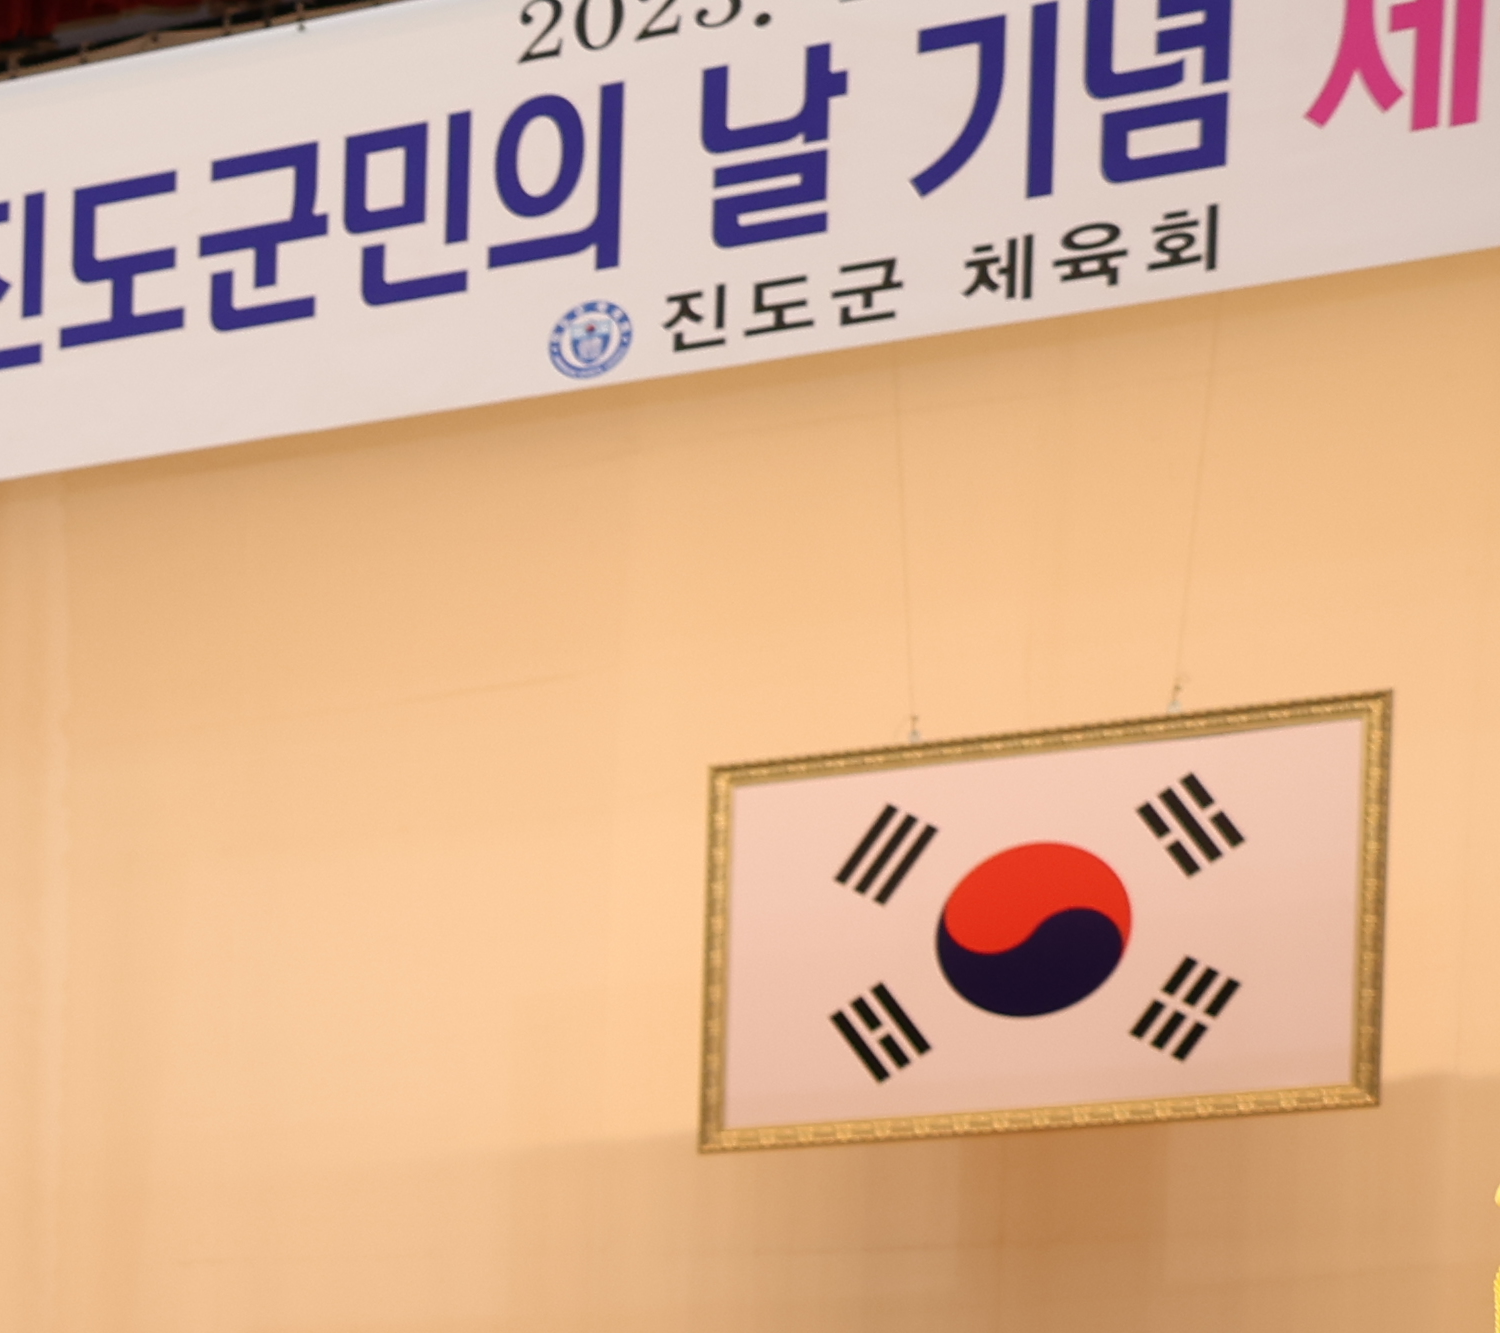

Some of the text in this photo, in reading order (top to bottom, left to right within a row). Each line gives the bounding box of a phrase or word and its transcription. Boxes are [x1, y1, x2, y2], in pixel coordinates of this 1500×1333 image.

[700, 42, 849, 249] 날
[908, 0, 1233, 200] 기념
[662, 256, 904, 353] 진도군
[962, 204, 1221, 302] 체육회
